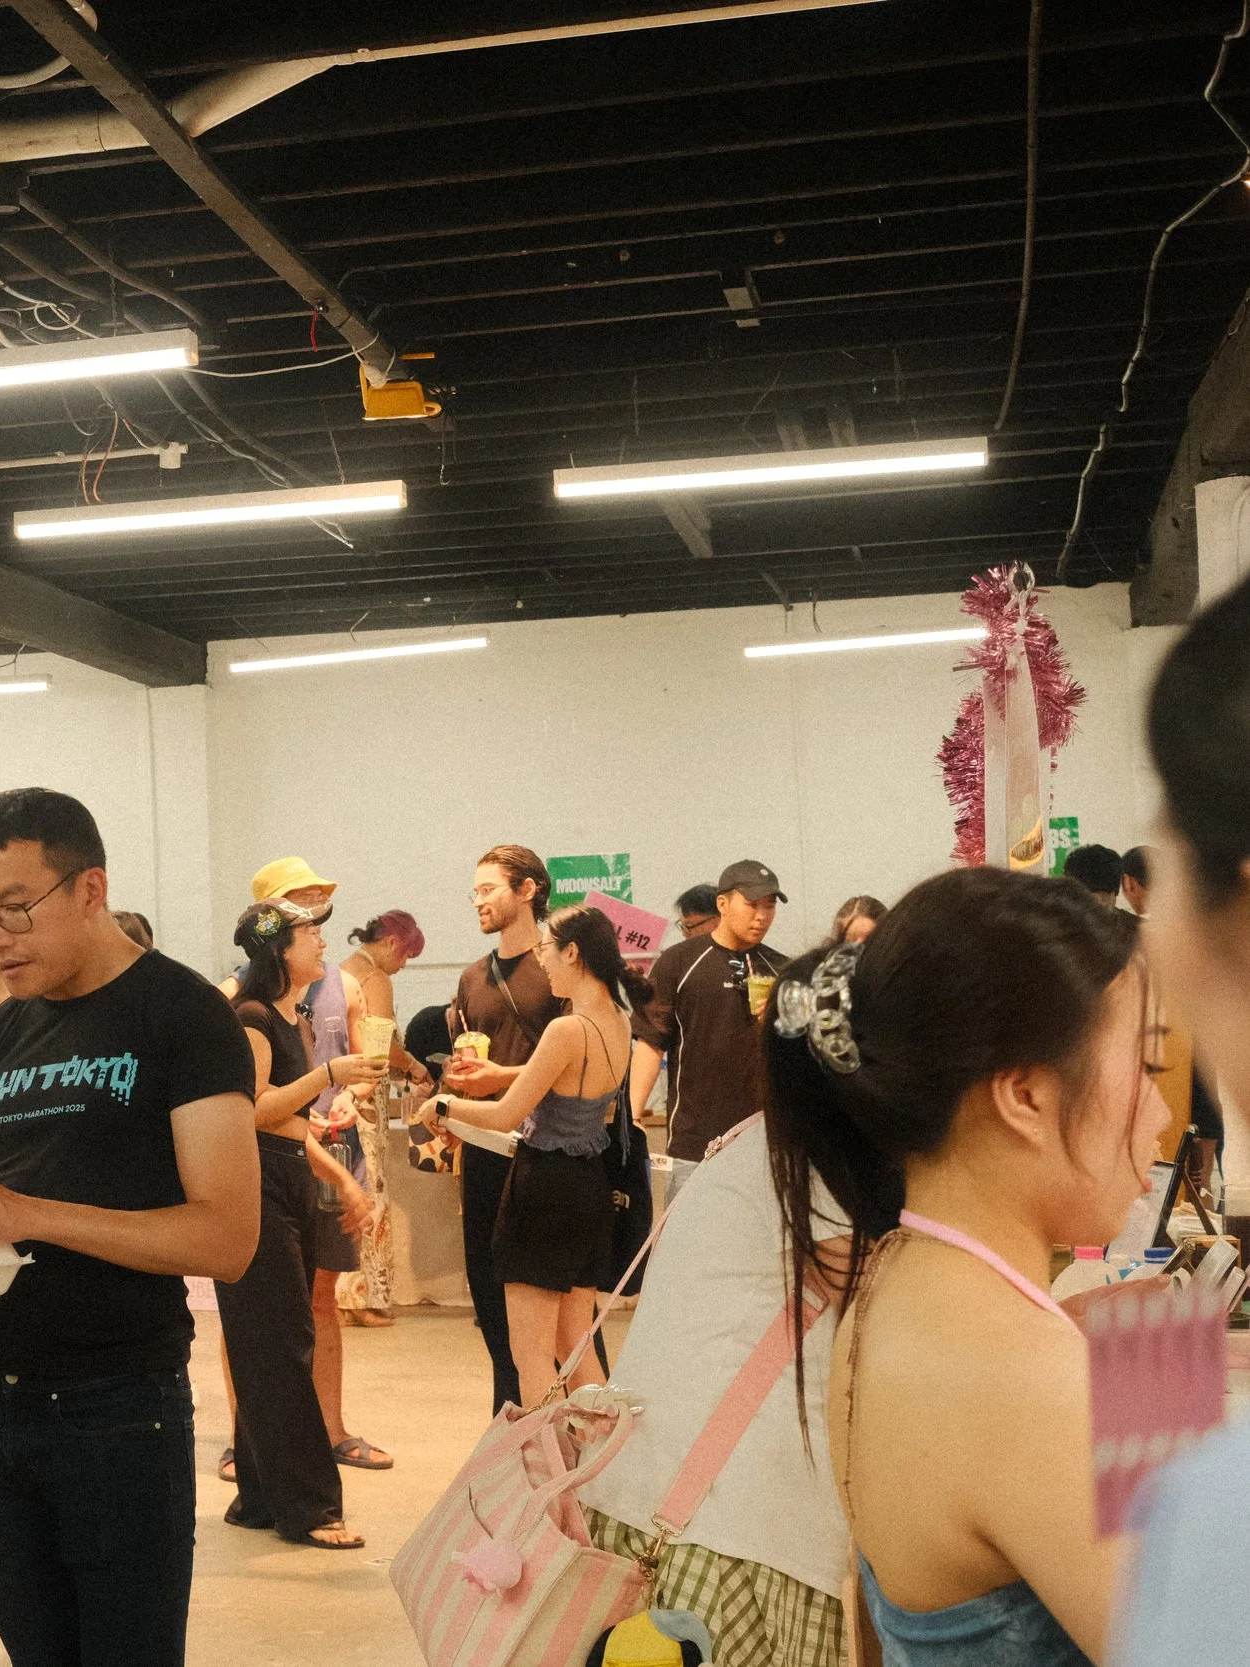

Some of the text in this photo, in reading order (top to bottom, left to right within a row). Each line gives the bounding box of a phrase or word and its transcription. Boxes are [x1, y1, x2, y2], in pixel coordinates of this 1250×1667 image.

[555, 876, 622, 894] MOONSALT
[625, 930, 651, 950] #12
[37, 1052, 139, 1106] TOKYO
[0, 1103, 86, 1124] TOKYO MARATHON 2025
